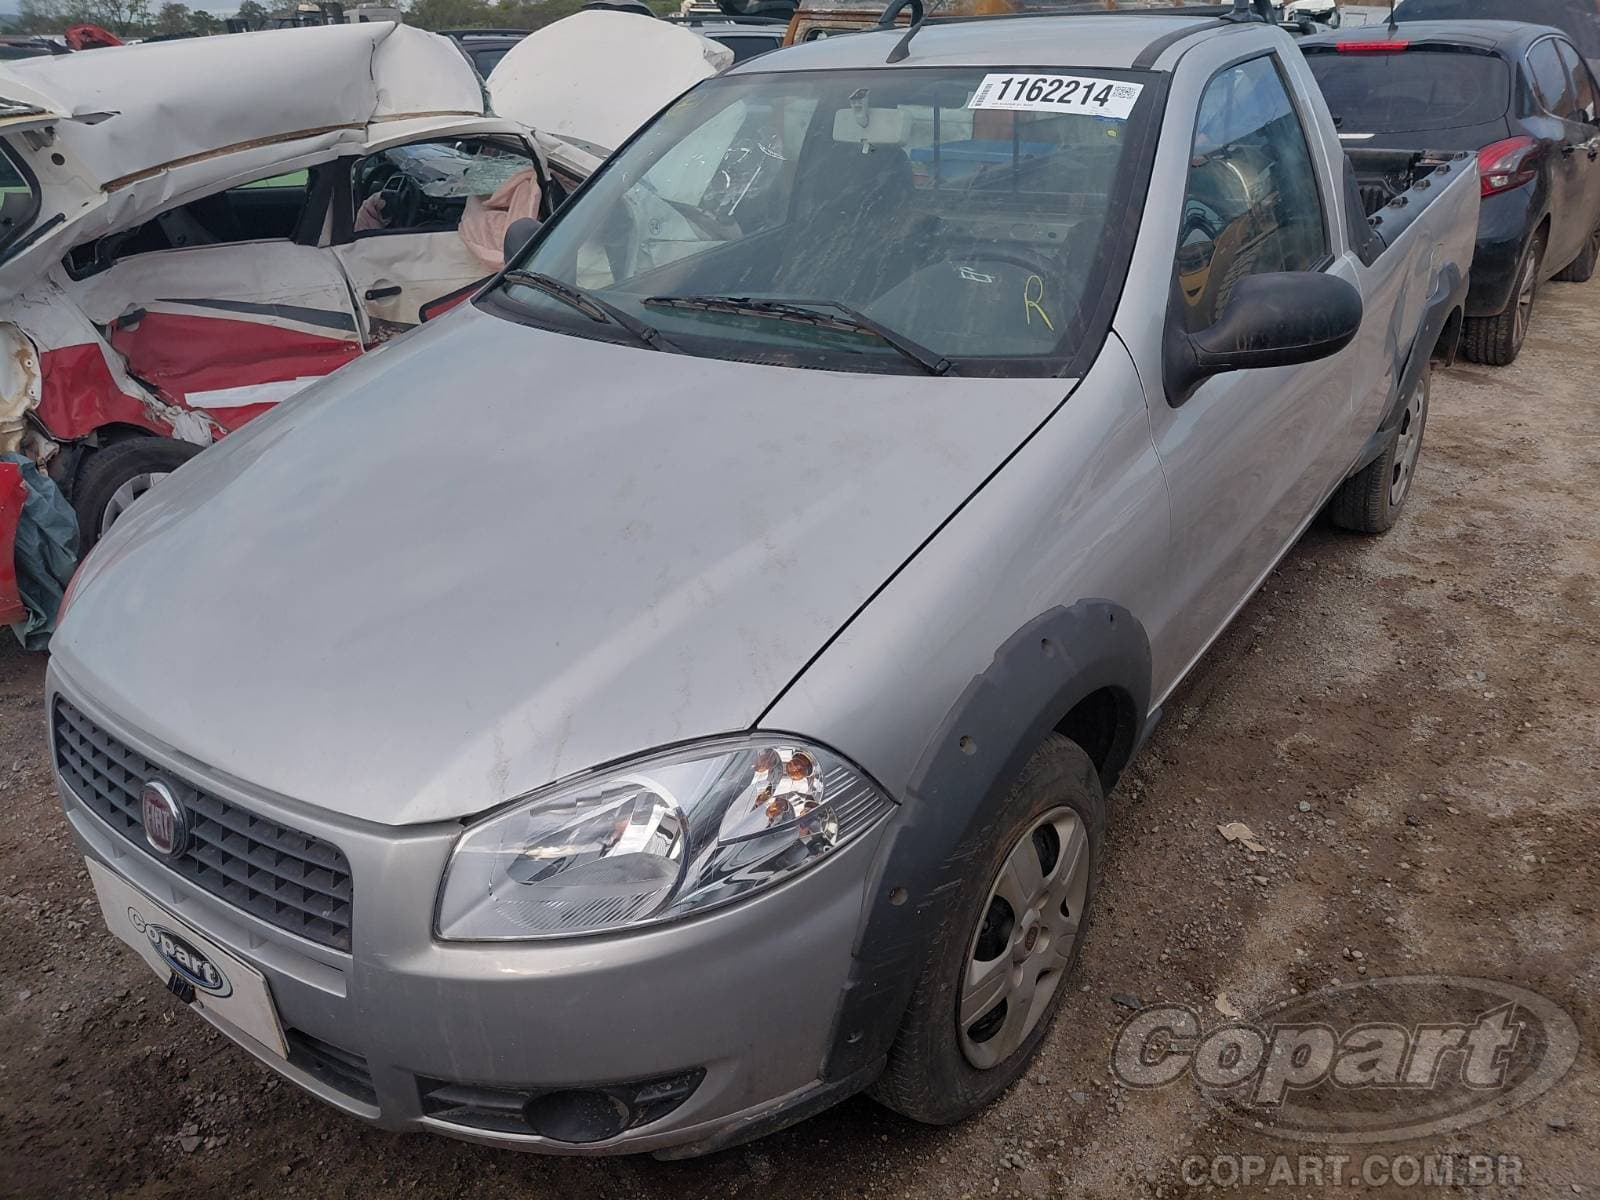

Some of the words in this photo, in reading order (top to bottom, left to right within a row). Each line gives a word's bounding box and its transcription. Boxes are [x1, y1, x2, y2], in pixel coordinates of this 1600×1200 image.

[998, 77, 1114, 107] 1162214
[1024, 275, 1054, 331] R
[146, 801, 170, 840] FIAT
[128, 907, 217, 986] Copart
